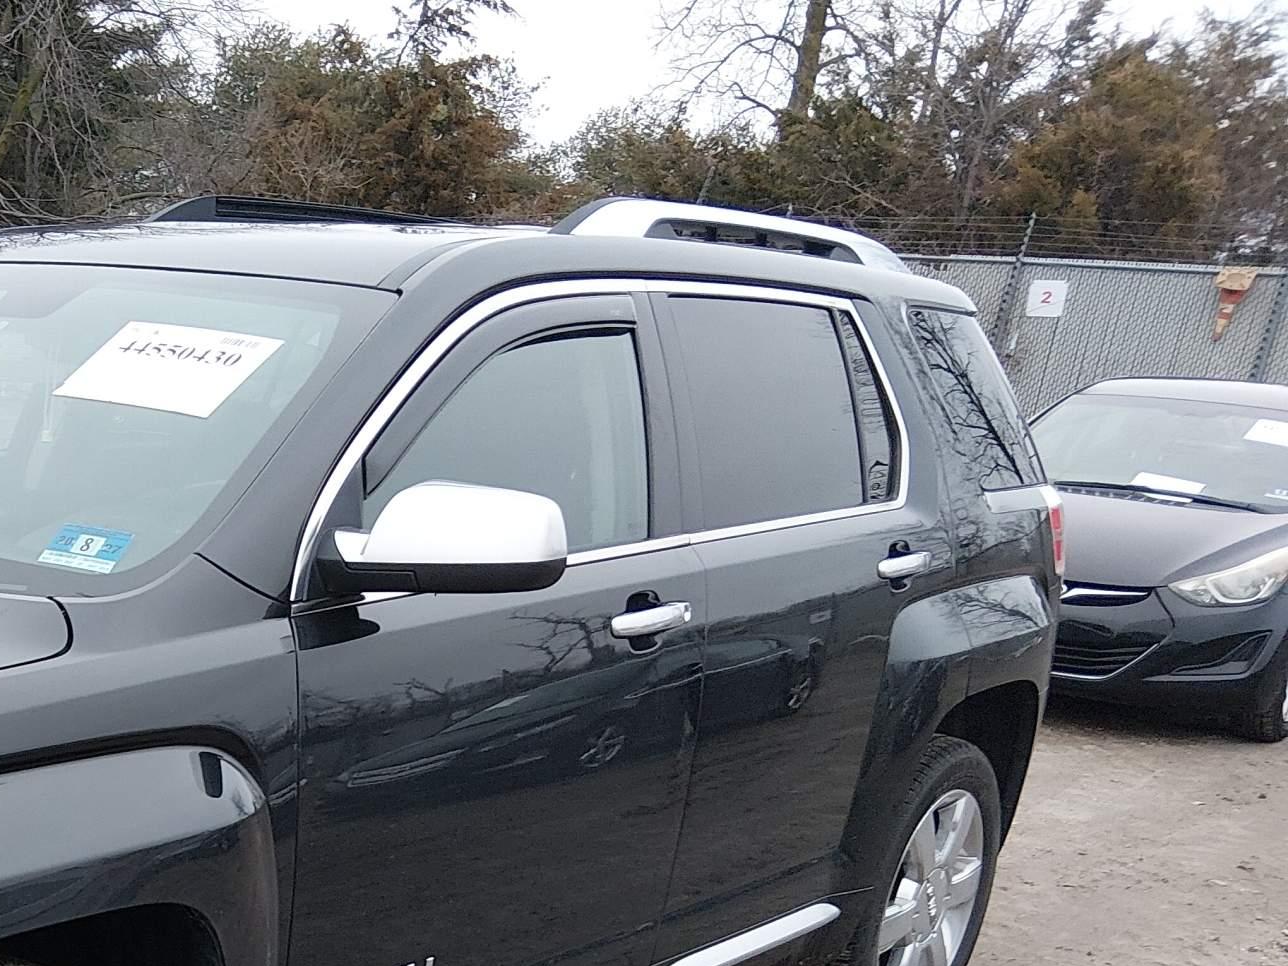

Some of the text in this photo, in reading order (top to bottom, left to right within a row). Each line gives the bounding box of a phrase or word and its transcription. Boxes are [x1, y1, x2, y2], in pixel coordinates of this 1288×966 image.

[1040, 291, 1053, 304] 2
[119, 340, 243, 367] 44550430
[79, 537, 94, 552] 8
